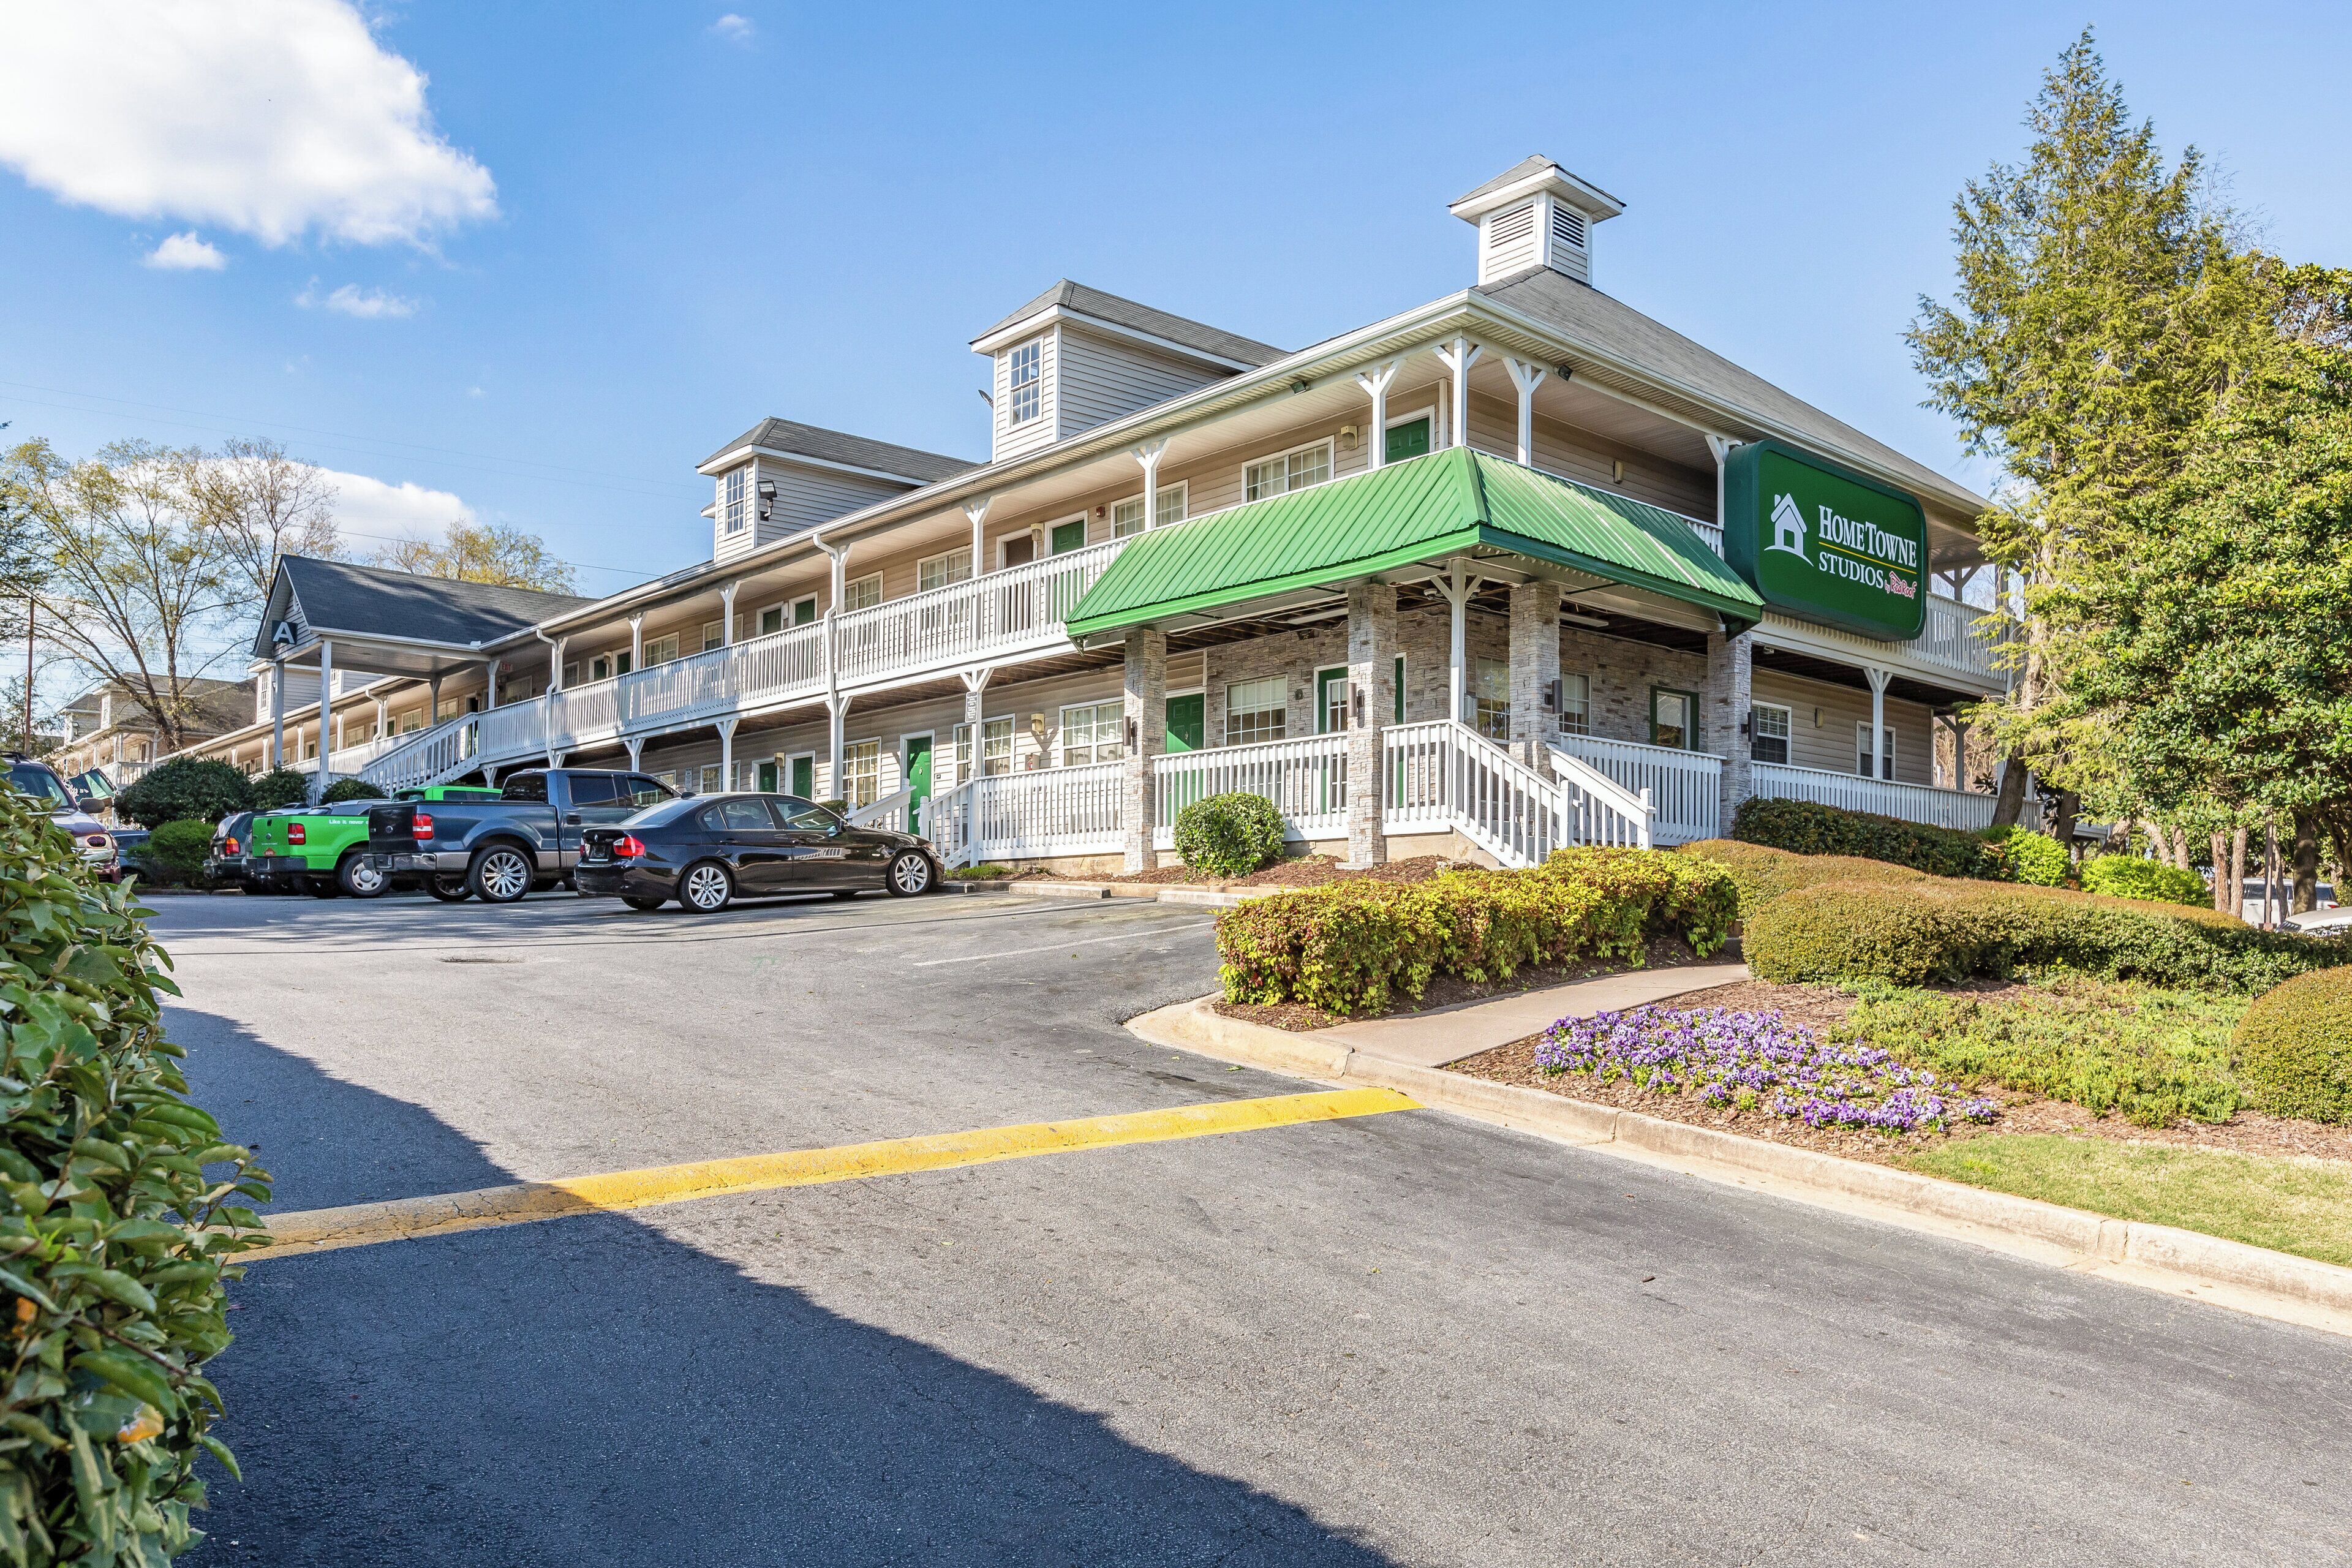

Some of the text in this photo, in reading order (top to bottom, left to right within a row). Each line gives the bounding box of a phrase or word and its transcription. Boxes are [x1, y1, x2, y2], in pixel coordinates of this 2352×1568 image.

[1819, 551, 1883, 589] STUDIOS
[1885, 579, 1890, 594] by
[273, 622, 295, 643] A
